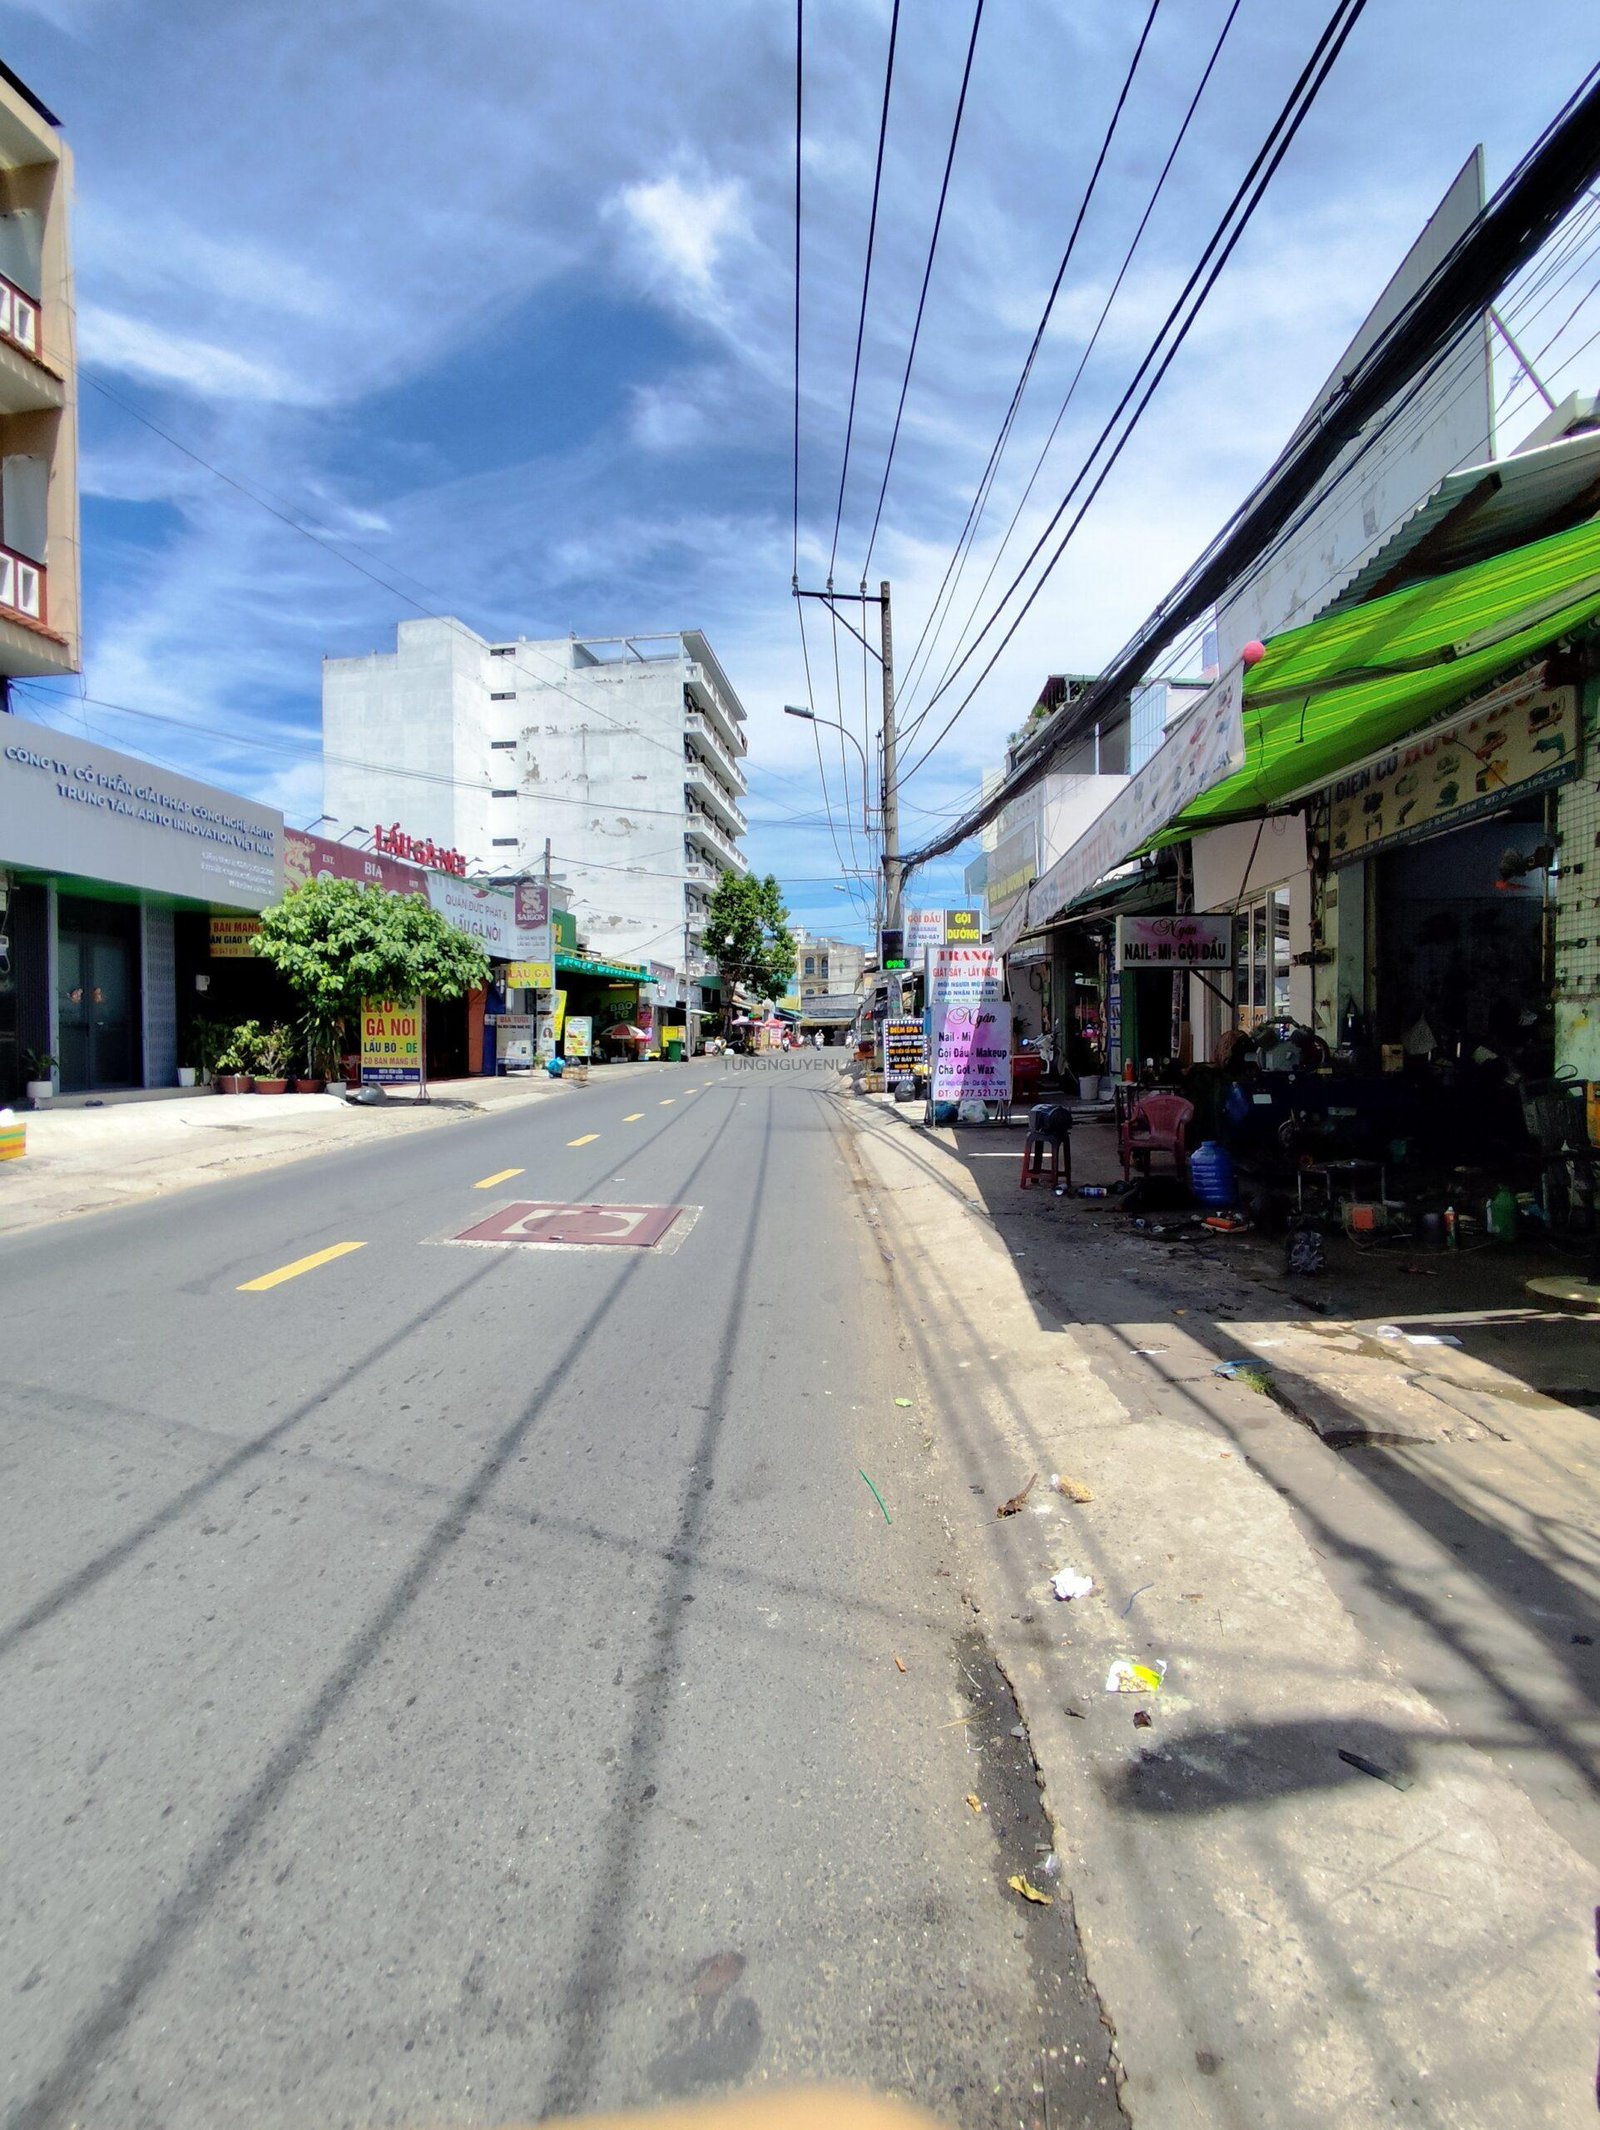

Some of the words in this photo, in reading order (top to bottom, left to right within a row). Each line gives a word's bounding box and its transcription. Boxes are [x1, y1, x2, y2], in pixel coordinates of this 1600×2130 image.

[5, 746, 50, 769] CÔNG
[52, 760, 71, 776] TY
[57, 783, 106, 807] TRUNG
[137, 808, 172, 826] ARITO
[173, 818, 235, 845] INNOVATION
[364, 861, 383, 879] BIA
[517, 913, 546, 921] SAIGON
[955, 913, 971, 925] GỘI
[937, 950, 993, 961] TRANG
[1125, 943, 1151, 960] NAIL
[366, 1014, 386, 1036] GÀ
[390, 1014, 416, 1036] NÒI
[938, 1032, 954, 1042] Nail
[961, 1032, 971, 1042] Mi
[976, 1047, 1007, 1060] Makeup
[938, 1064, 953, 1075] Chà
[977, 1064, 995, 1075] Wax
